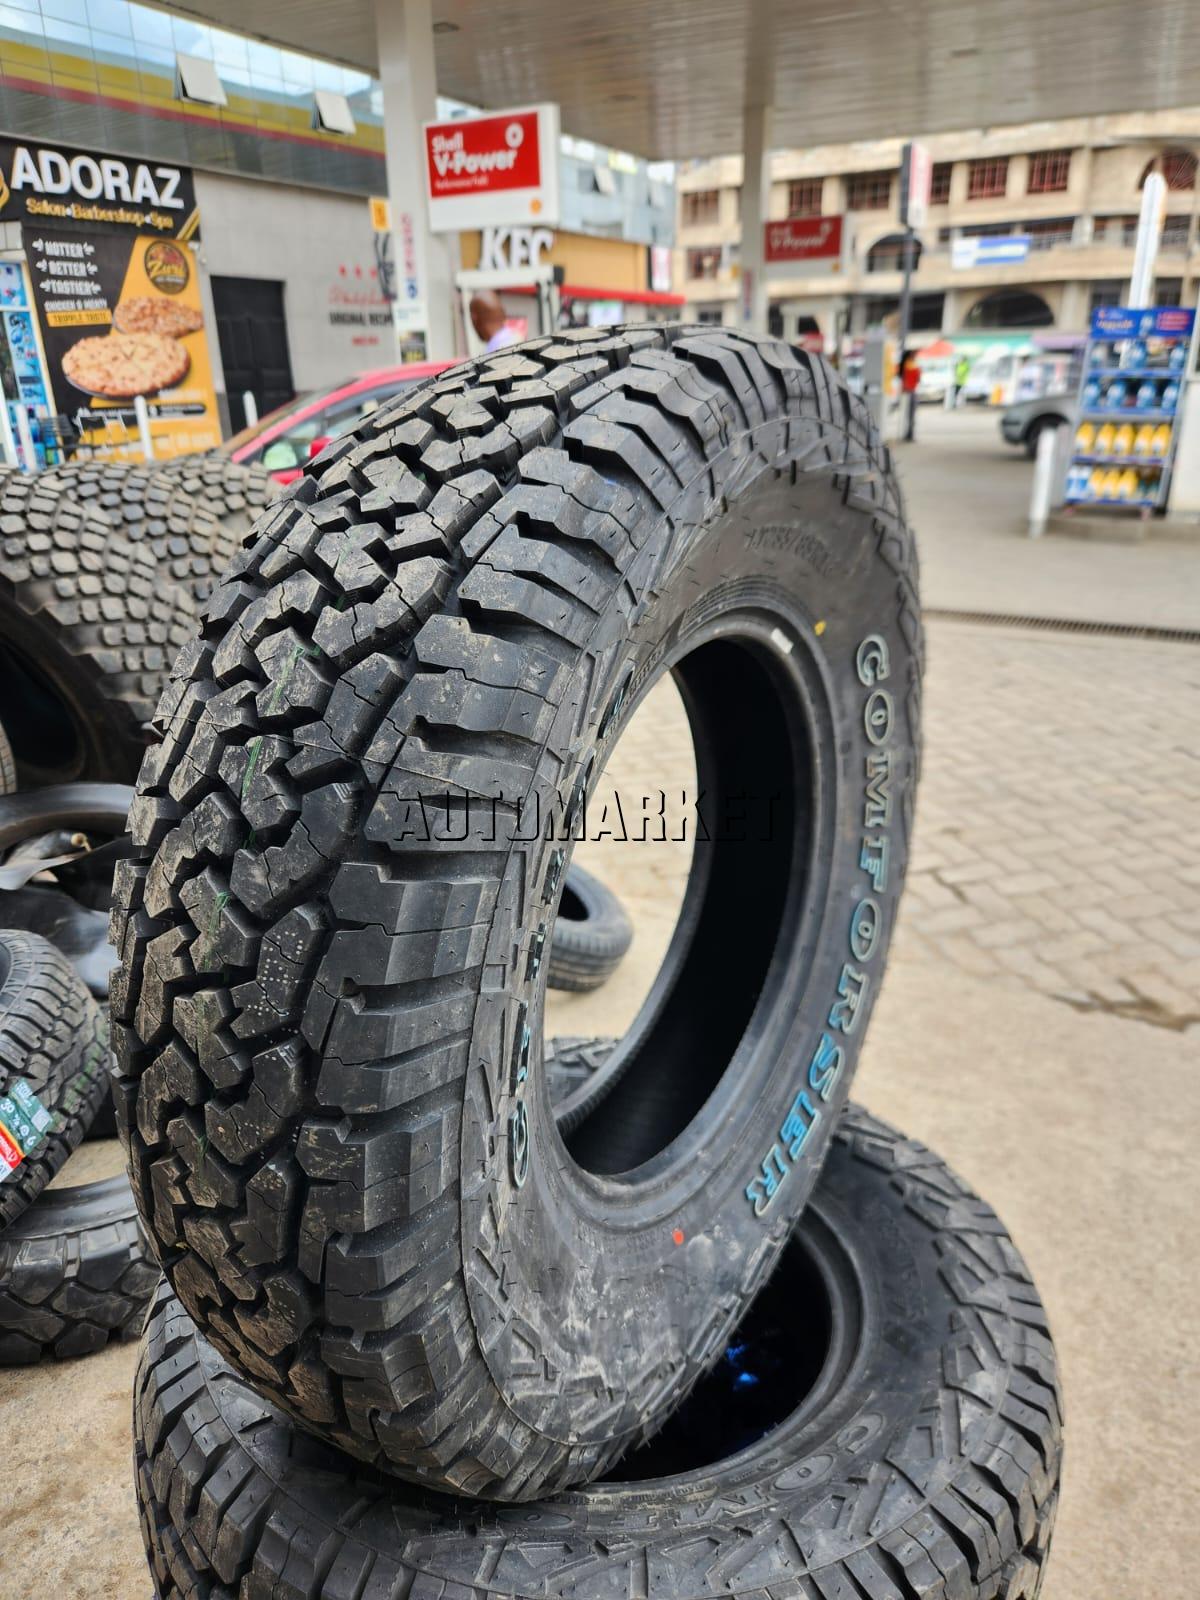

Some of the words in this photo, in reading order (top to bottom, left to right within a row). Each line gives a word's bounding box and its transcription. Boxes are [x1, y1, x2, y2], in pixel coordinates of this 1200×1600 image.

[432, 131, 464, 152] Shell
[432, 148, 519, 177] V-Power
[10, 146, 185, 209] ADORAZ
[26, 197, 67, 217] Salon
[71, 203, 144, 228] Barbershop
[149, 211, 174, 231] Spa
[44, 241, 85, 258] HOTTER
[478, 226, 554, 272] KFC
[48, 261, 87, 277] BETTER
[50, 279, 93, 295] TASTIER
[746, 633, 896, 1217] COMFORSER
